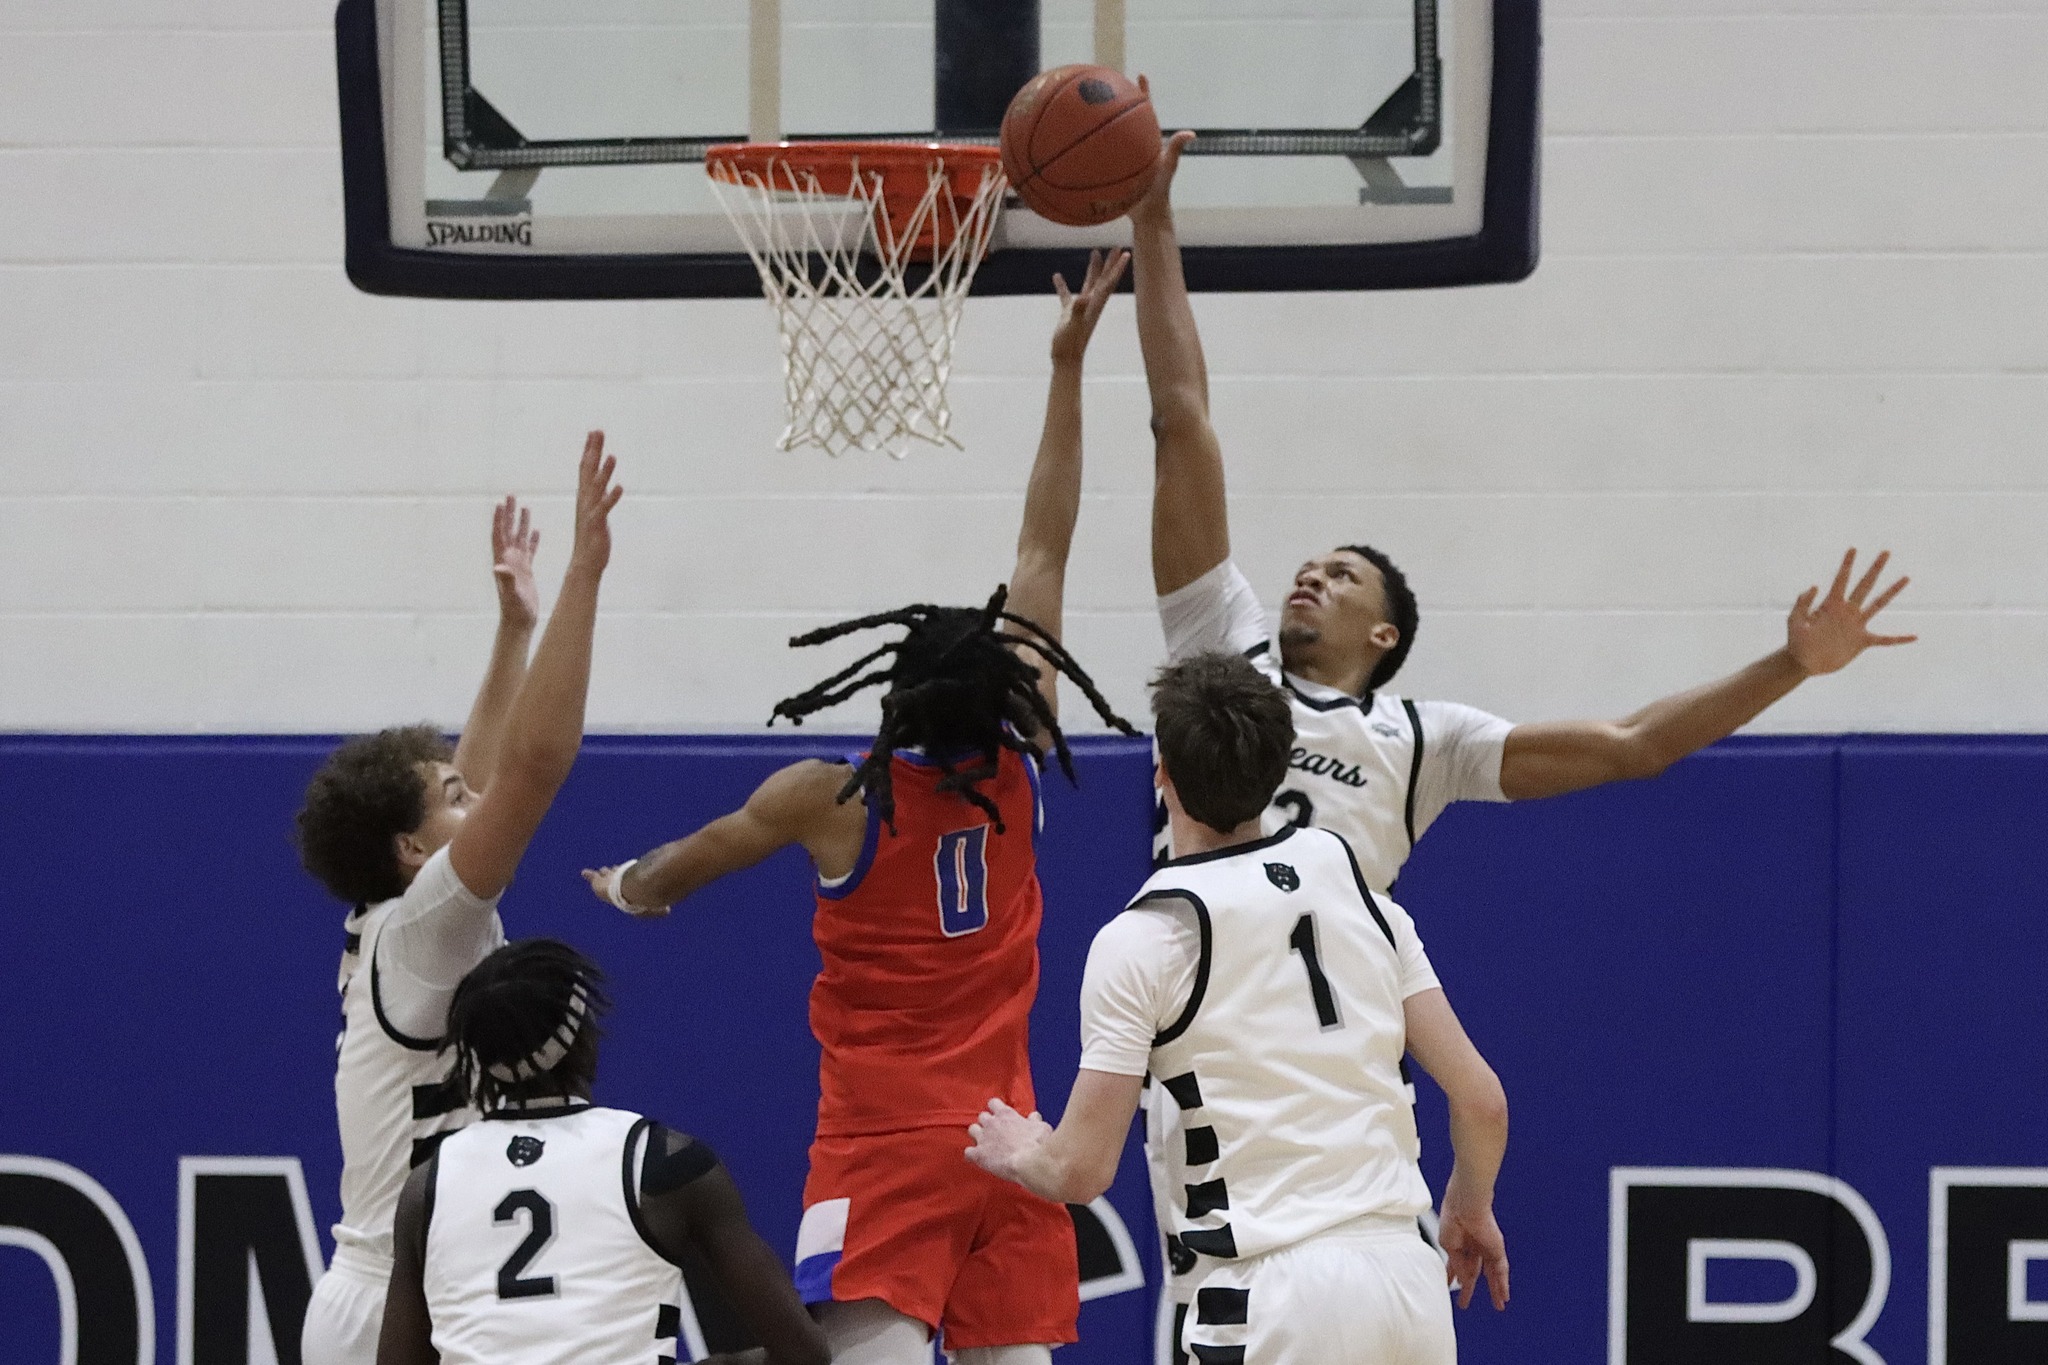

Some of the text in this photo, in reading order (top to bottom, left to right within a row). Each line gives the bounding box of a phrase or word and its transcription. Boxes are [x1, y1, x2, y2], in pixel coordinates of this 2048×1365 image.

[425, 220, 532, 246] SPALDING
[1288, 746, 1368, 788] ears
[933, 822, 990, 938] 0
[1288, 910, 1345, 1034] 1
[492, 1186, 561, 1303] 2
